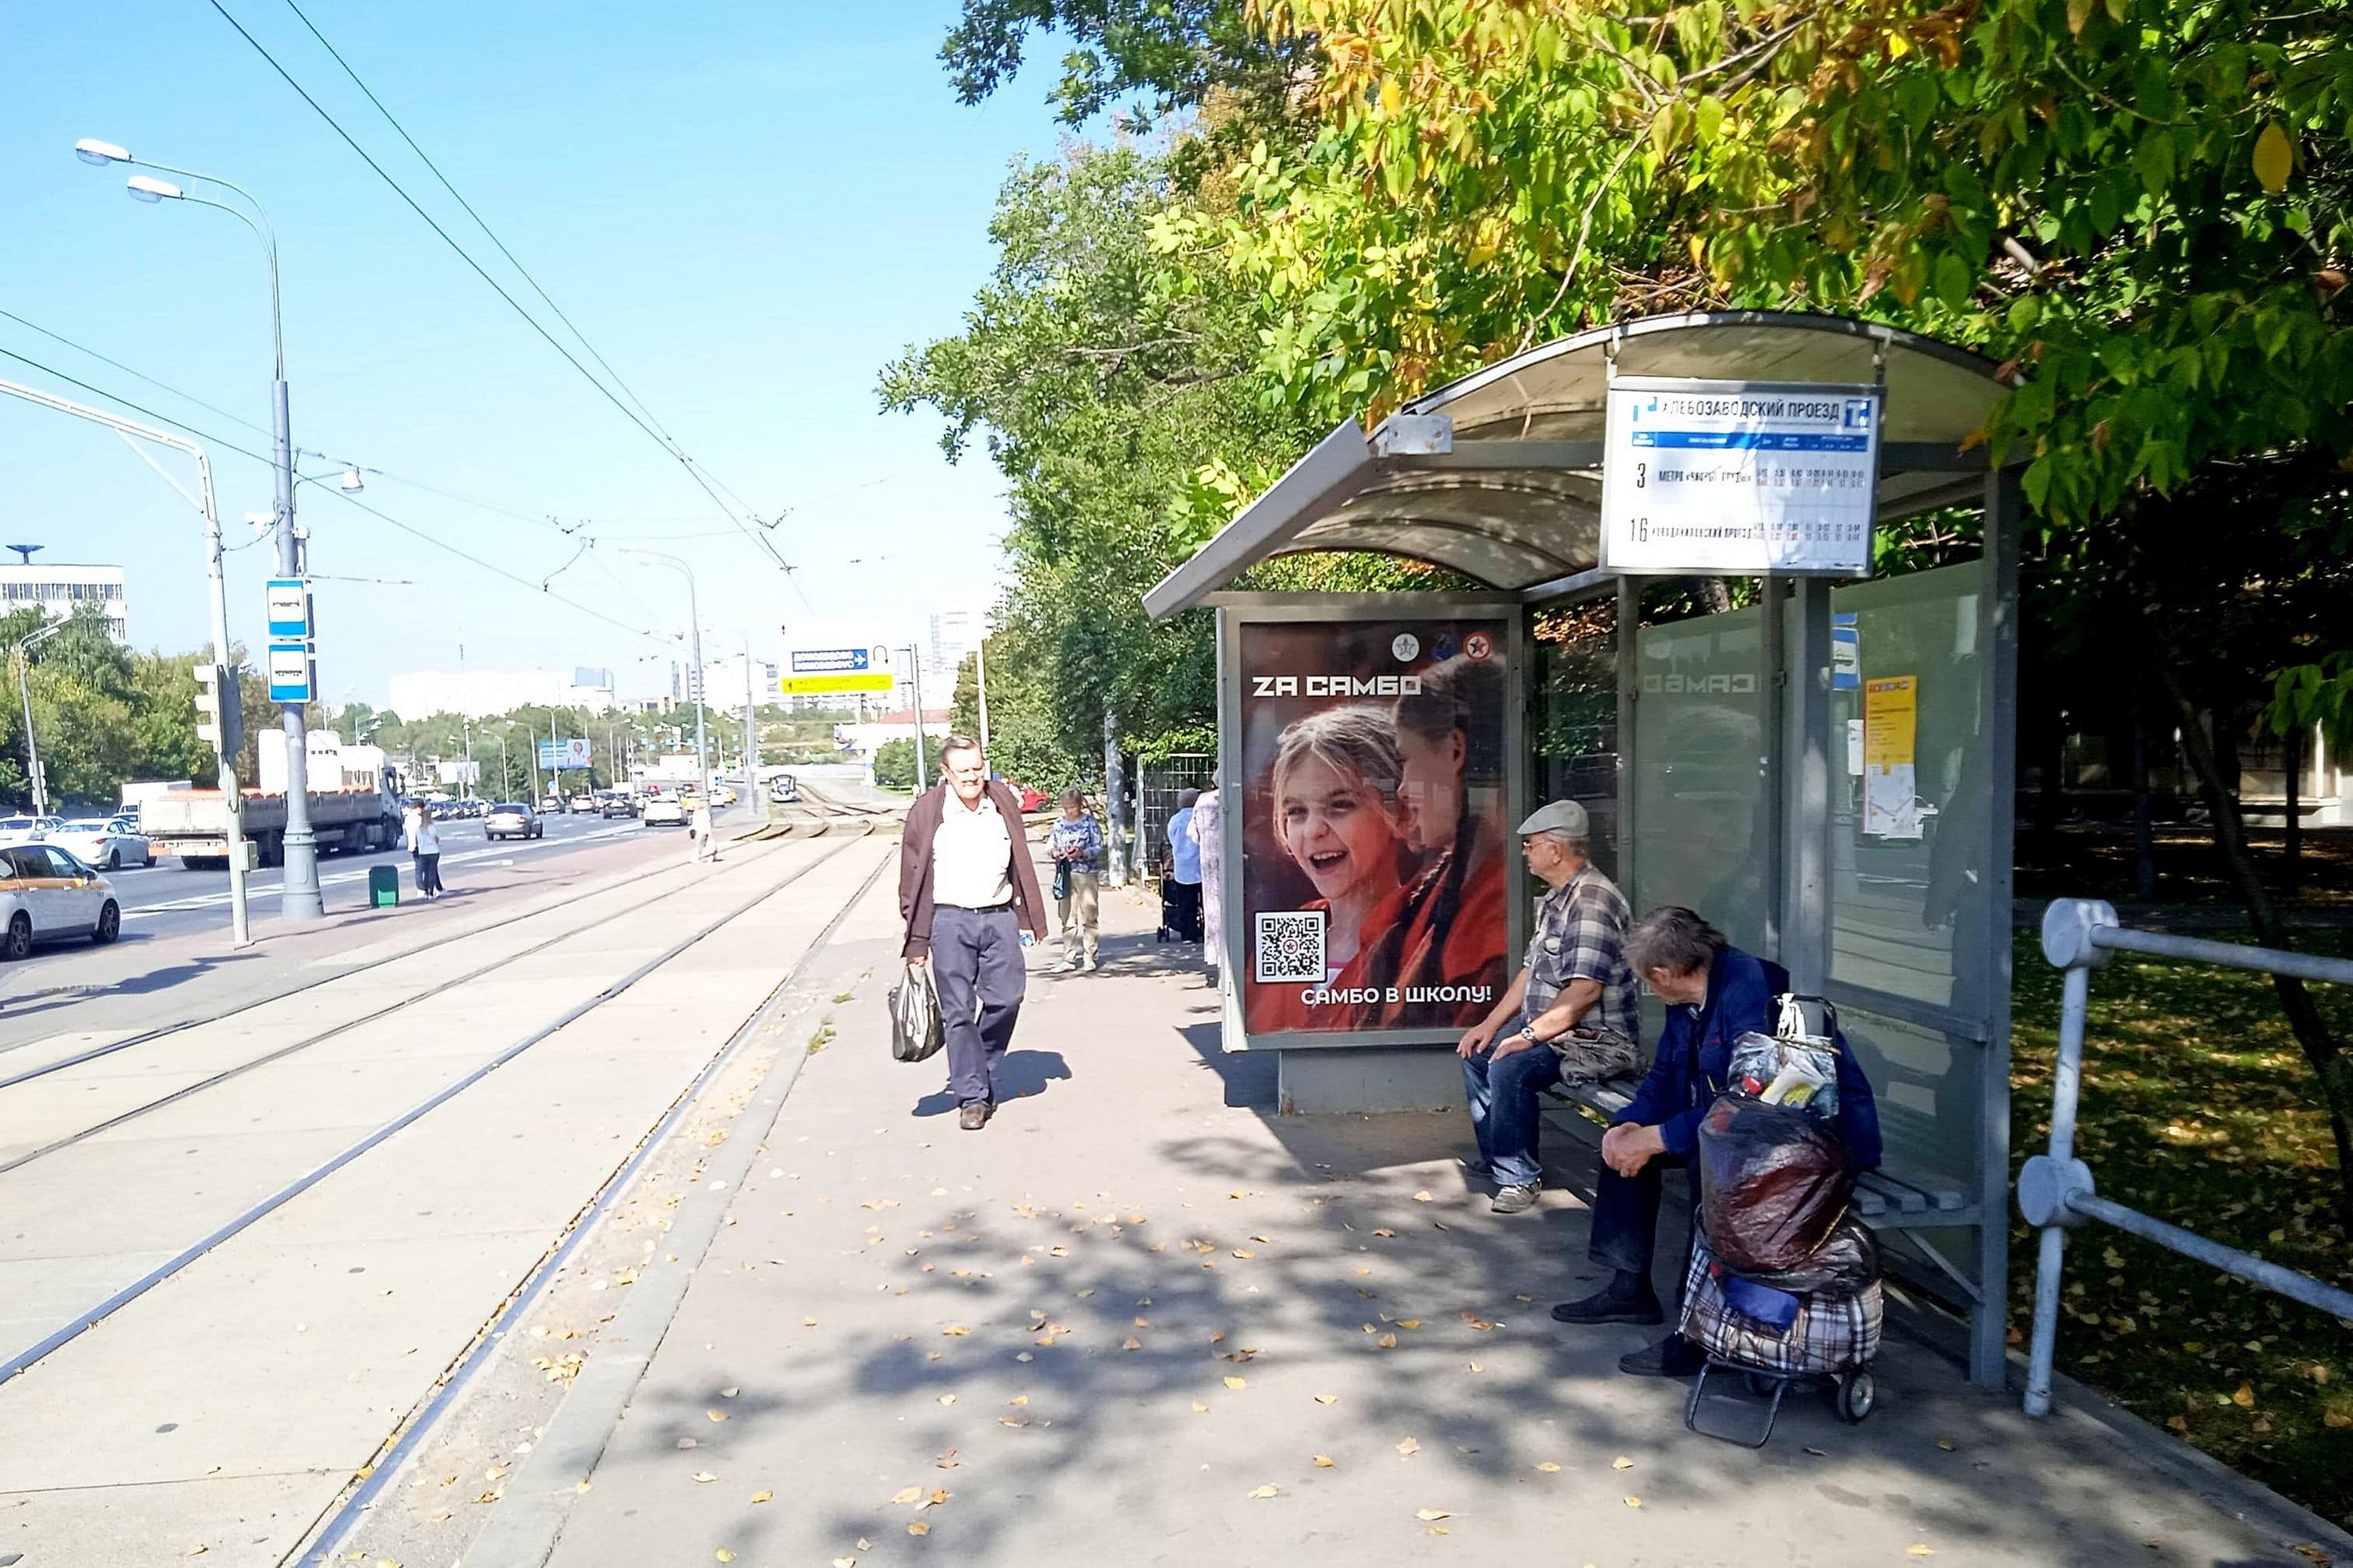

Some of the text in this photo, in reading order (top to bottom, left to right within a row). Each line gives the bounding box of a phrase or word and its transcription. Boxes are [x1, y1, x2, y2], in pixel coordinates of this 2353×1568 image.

[1662, 398, 1840, 420] ЛЕБОЗАВОДСКИЙ ПРОЕЗД
[1636, 462, 1646, 488] 3
[1631, 518, 1648, 542] 16
[1306, 675, 1422, 696] САМБО
[1301, 986, 1492, 1005] САМБО В ШКОЛУ!
